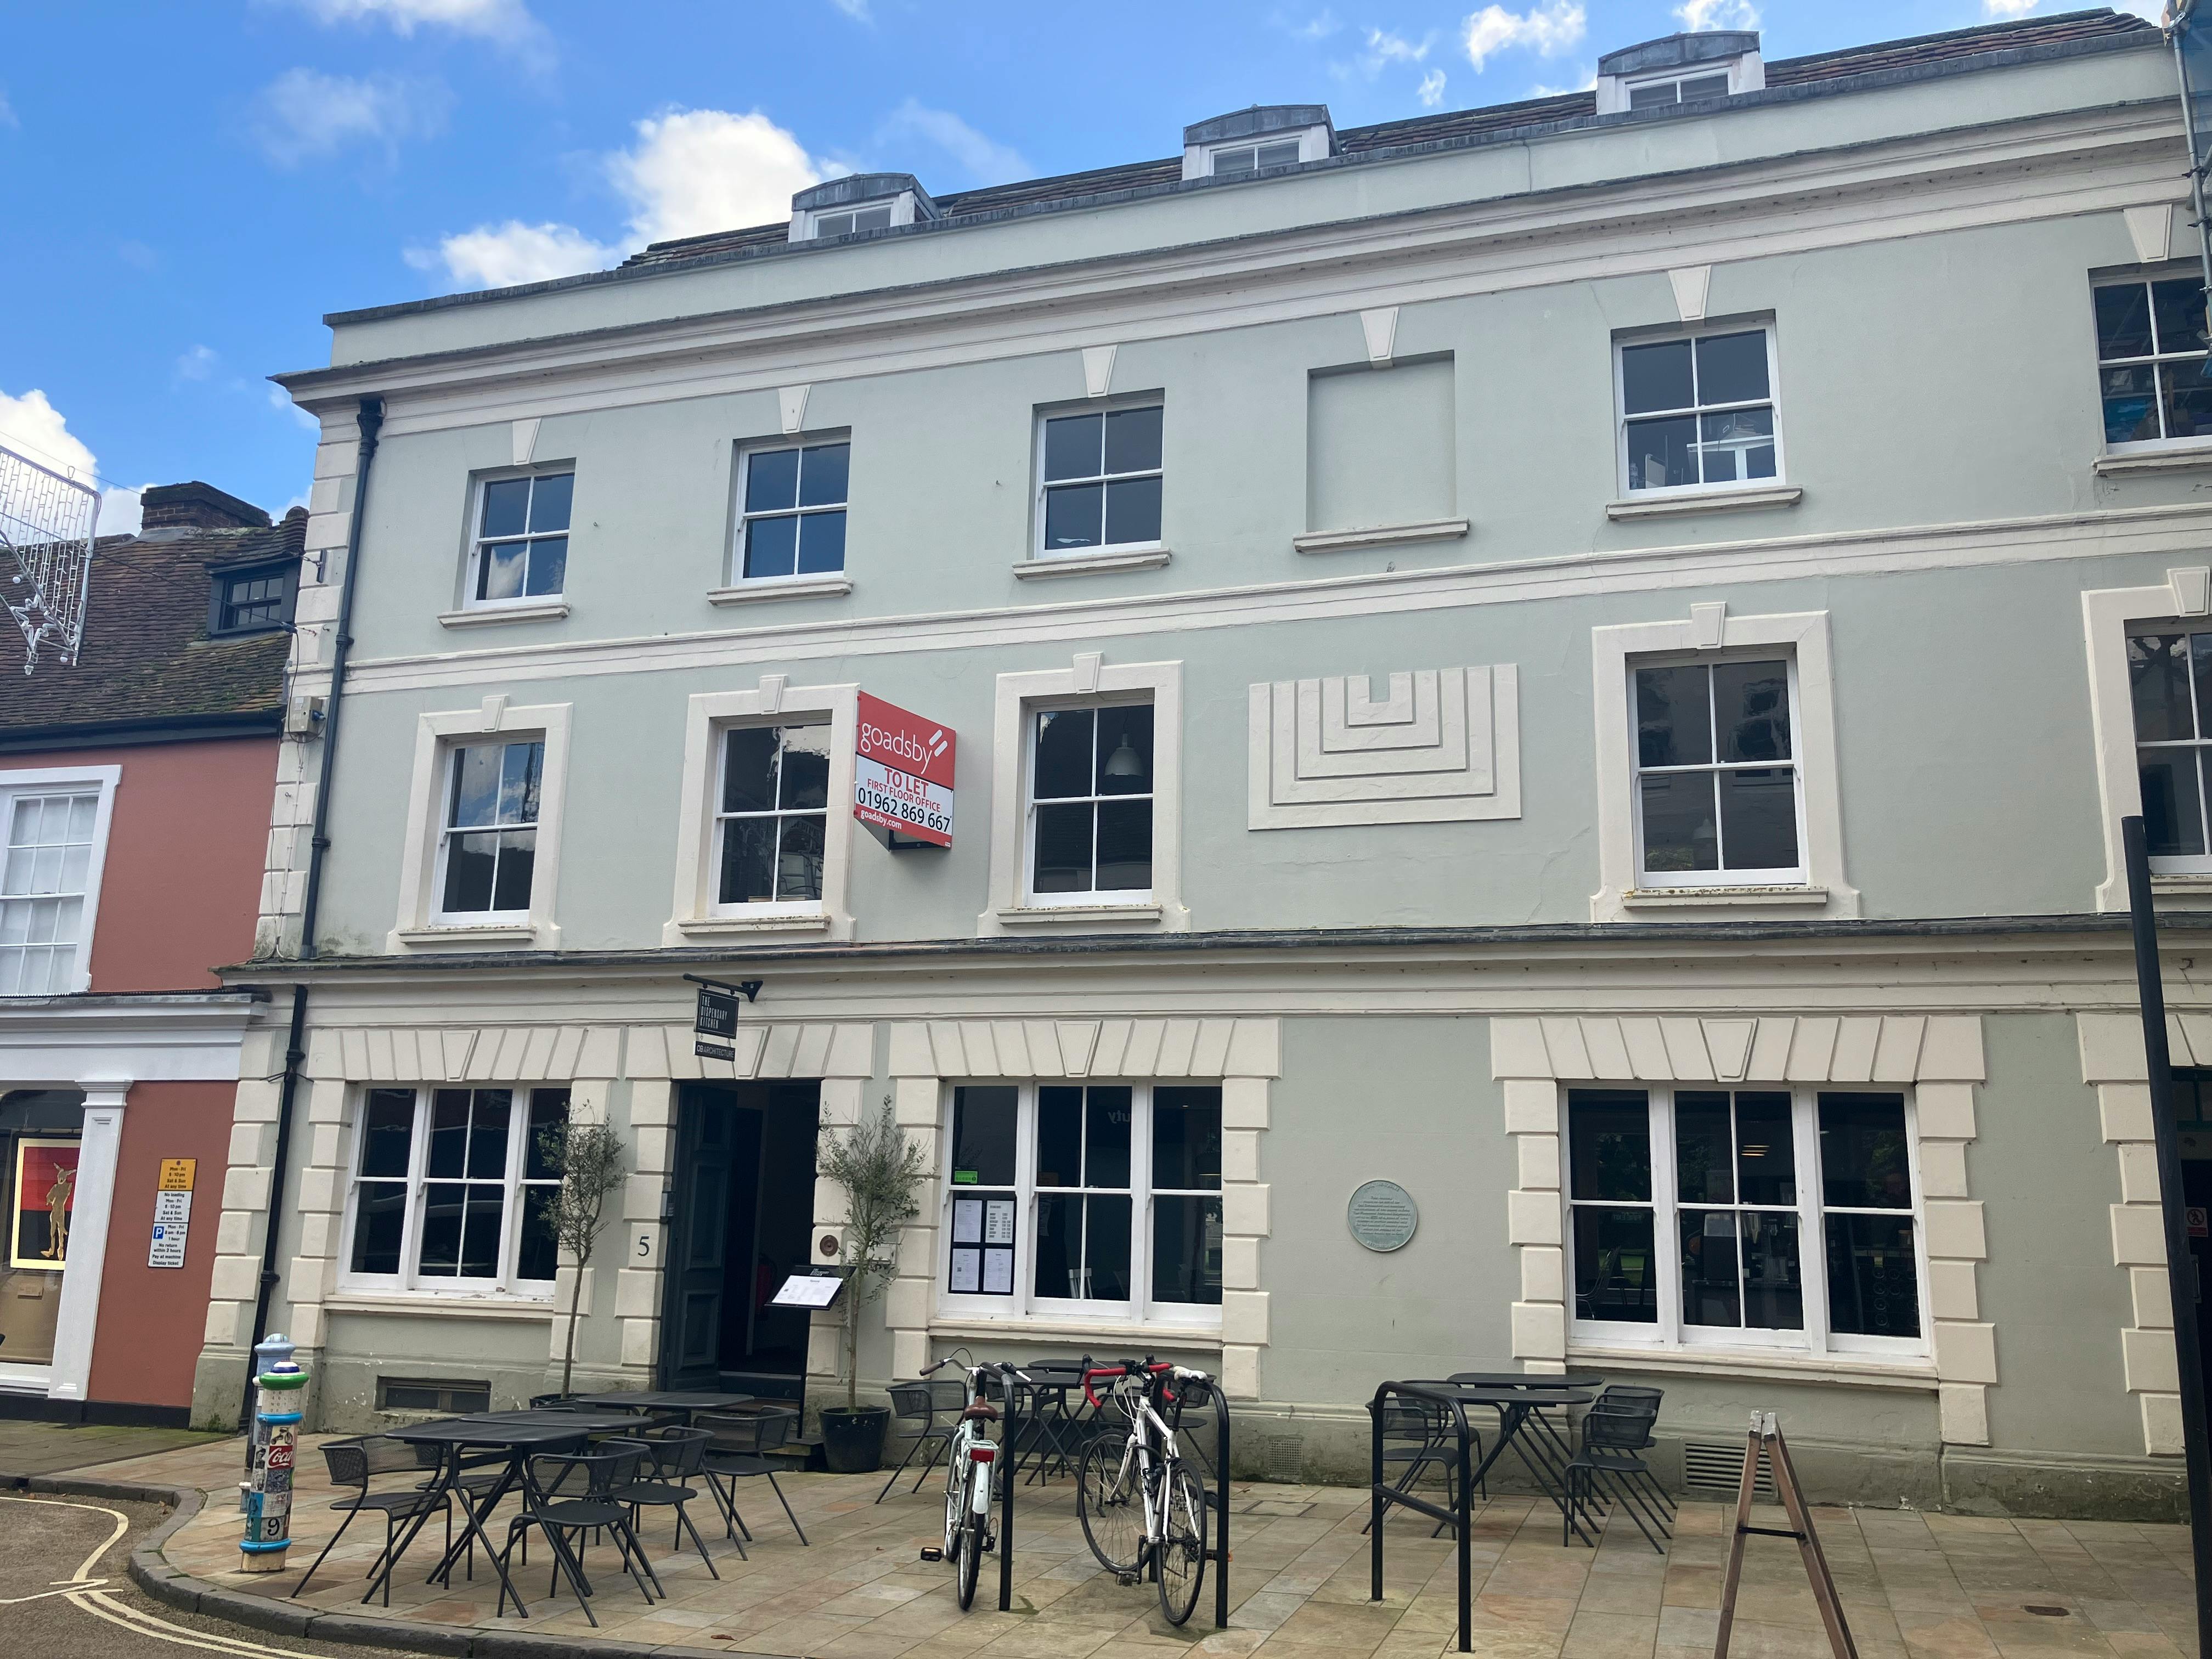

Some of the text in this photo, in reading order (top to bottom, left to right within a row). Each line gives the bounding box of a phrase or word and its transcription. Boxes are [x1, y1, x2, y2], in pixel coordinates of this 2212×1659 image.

[860, 722, 933, 775] goadsby
[884, 767, 929, 798] TO LET
[867, 778, 941, 812] FIRST FLOOR OFFICE
[858, 787, 950, 833] 01962 869 667
[860, 809, 902, 830] goadsby.com
[702, 995, 711, 1007] THE
[699, 1016, 719, 1029] KITCHEN
[701, 1006, 728, 1020] DISPENSARY
[703, 1047, 734, 1058] ARCHITECTURE
[155, 1227, 162, 1238] P
[637, 1235, 650, 1256] 5
[268, 1447, 292, 1468] Coca
[267, 1517, 280, 1536] 9
